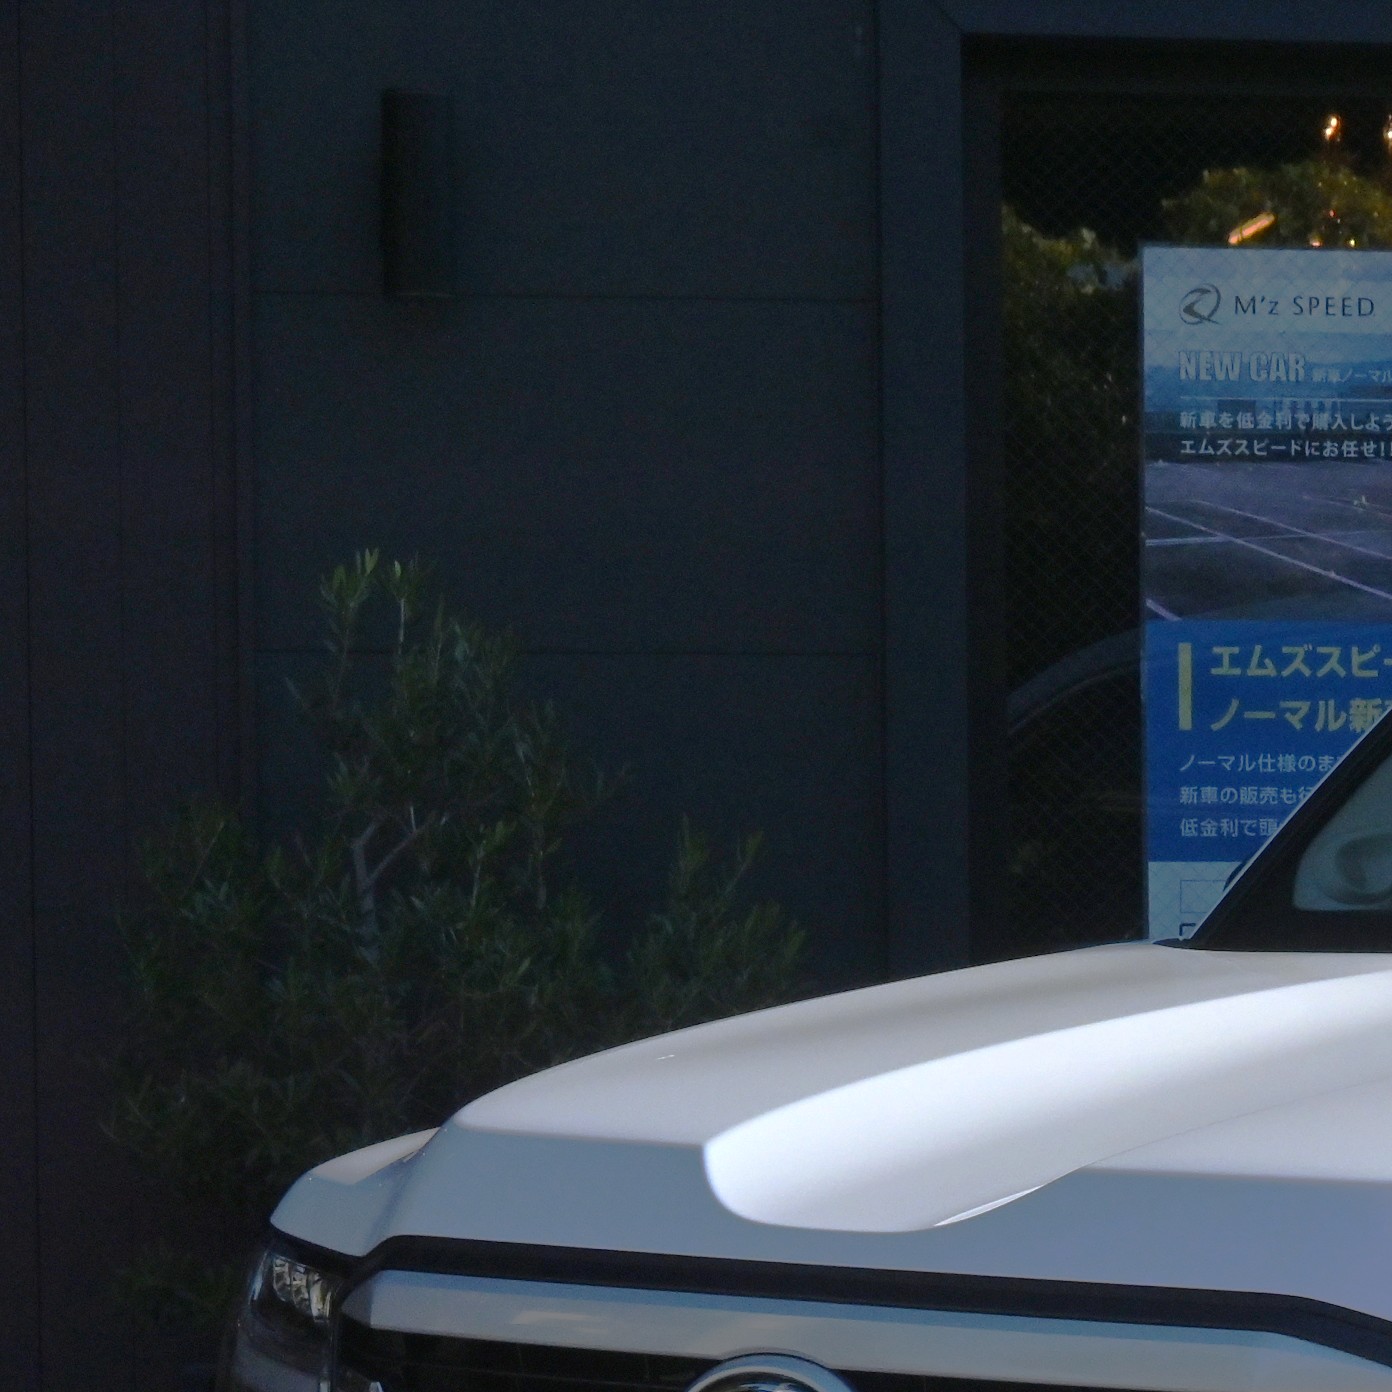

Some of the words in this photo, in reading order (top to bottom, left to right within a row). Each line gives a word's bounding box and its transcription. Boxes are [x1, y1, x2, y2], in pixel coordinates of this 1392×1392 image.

[1234, 294, 1279, 317] M'z
[1293, 295, 1376, 318] SPEED
[1178, 351, 1243, 382] NEW
[1249, 351, 1306, 383] CAR
[1179, 753, 1343, 773] ノーマル仕様のま
